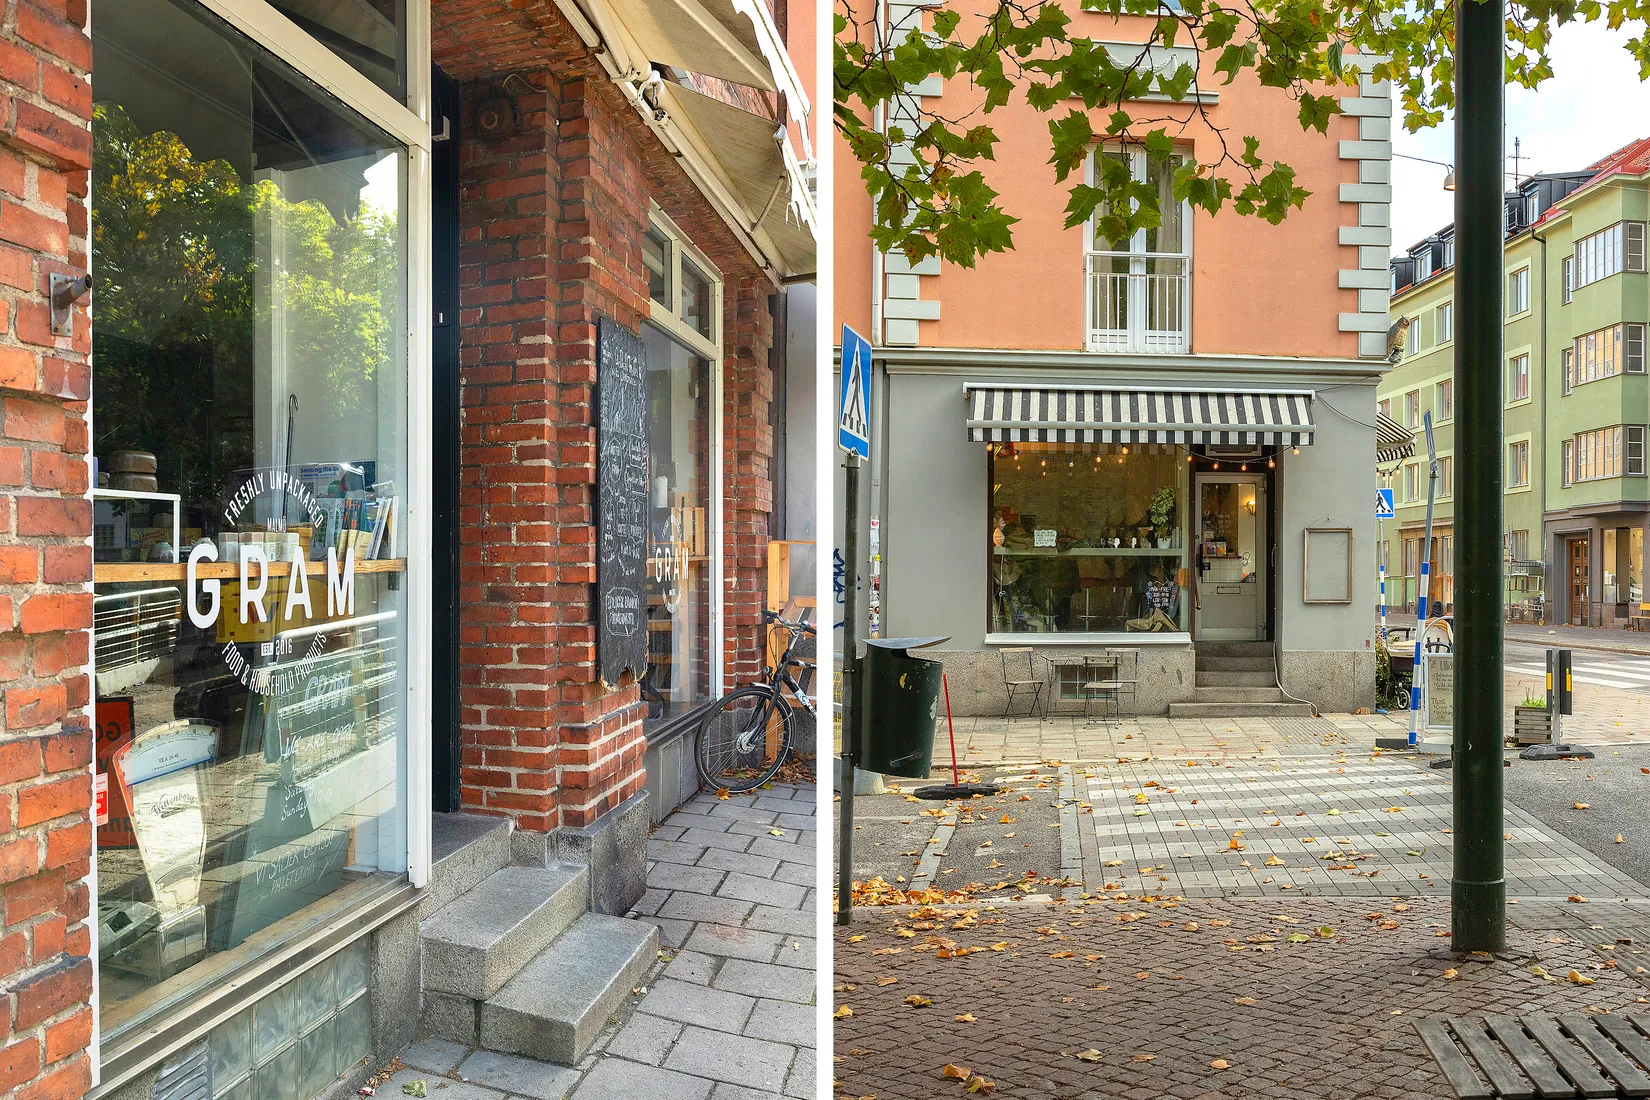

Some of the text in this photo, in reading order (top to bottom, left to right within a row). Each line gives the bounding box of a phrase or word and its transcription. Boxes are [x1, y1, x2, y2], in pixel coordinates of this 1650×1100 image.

[224, 470, 324, 529] FRESHLY UNPACKAGED
[186, 543, 355, 629] GRAM
[655, 546, 689, 583] GRAM
[221, 629, 327, 696] FOOD & HOUSEHOLD PRODUCTS
[275, 638, 293, 655] 2016
[304, 671, 350, 715] GRAM
[281, 797, 308, 820] Sunday
